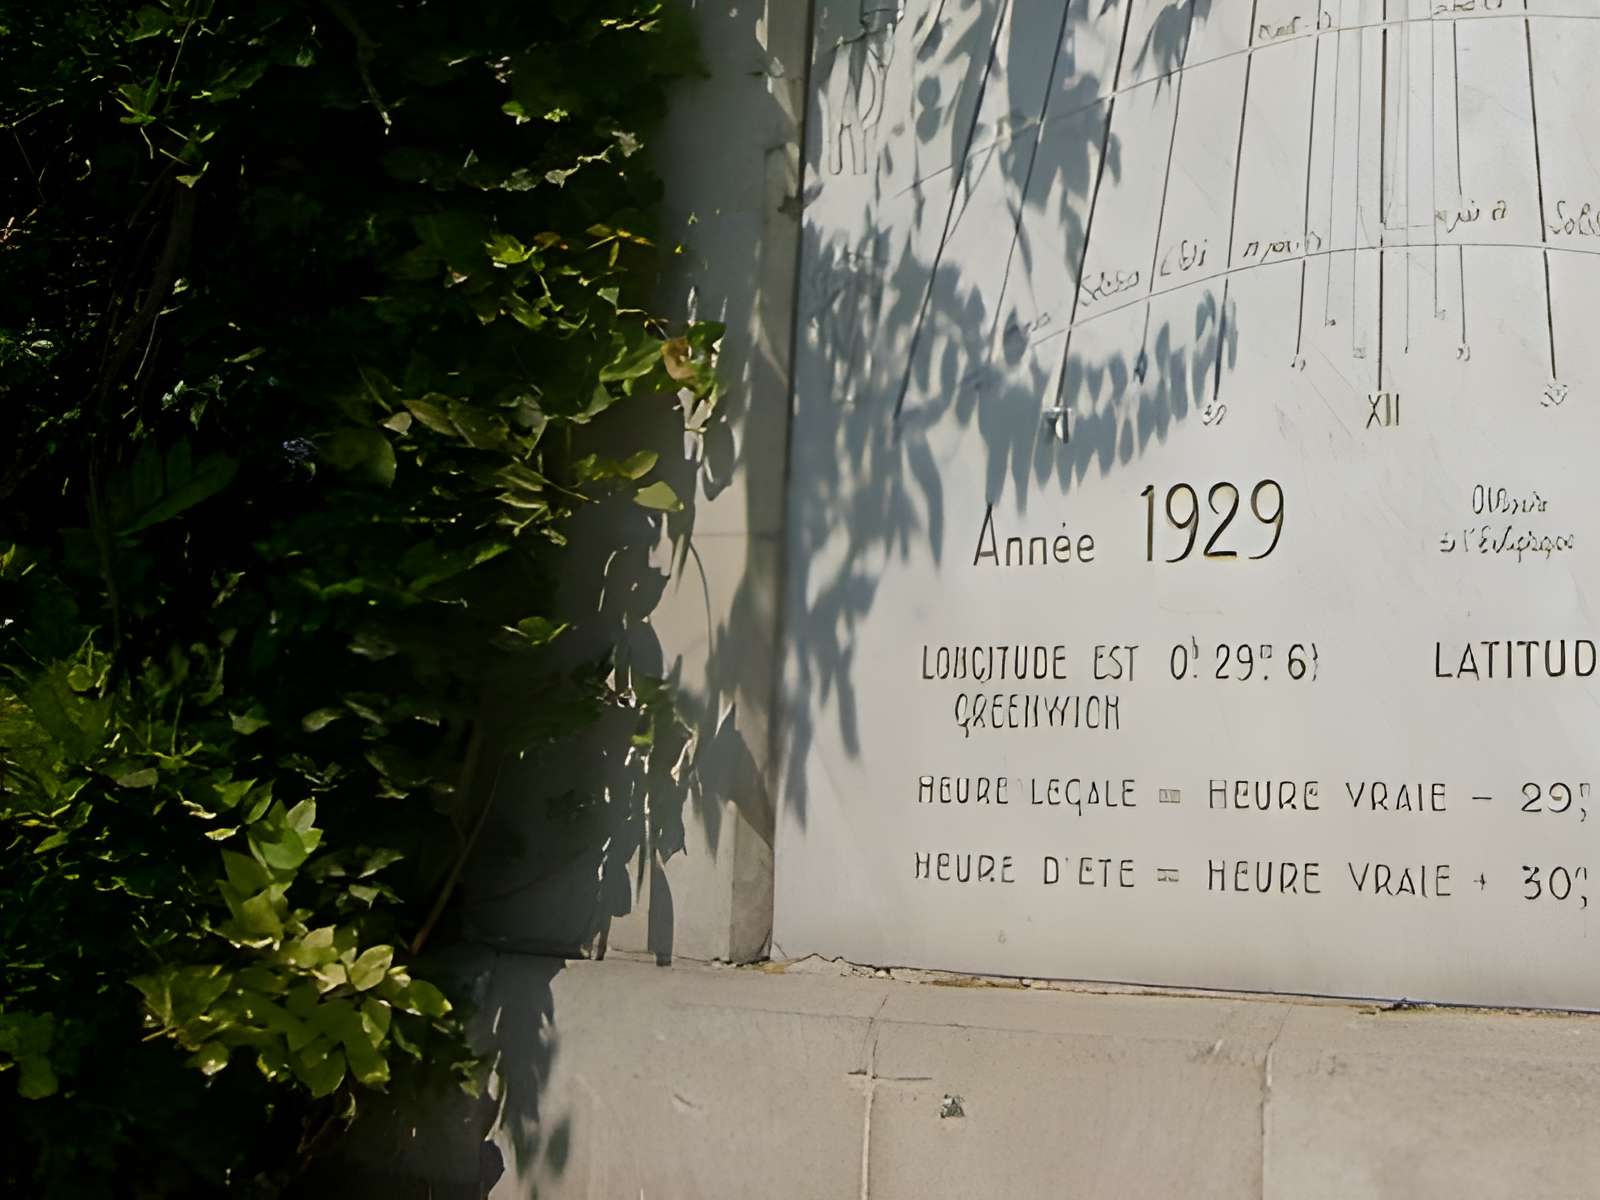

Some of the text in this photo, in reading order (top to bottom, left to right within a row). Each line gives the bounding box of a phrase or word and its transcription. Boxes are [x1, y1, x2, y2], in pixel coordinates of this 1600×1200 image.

[1140, 479, 1284, 563] 1929
[1094, 645, 1140, 682] EST
[919, 776, 1008, 804] HEURE
[1209, 780, 1320, 810] HEURE
[1345, 782, 1446, 812] VRAIE
[914, 852, 1015, 883] HEURE
[1208, 859, 1321, 894] HEURE
[1348, 862, 1451, 898] VRAIE
